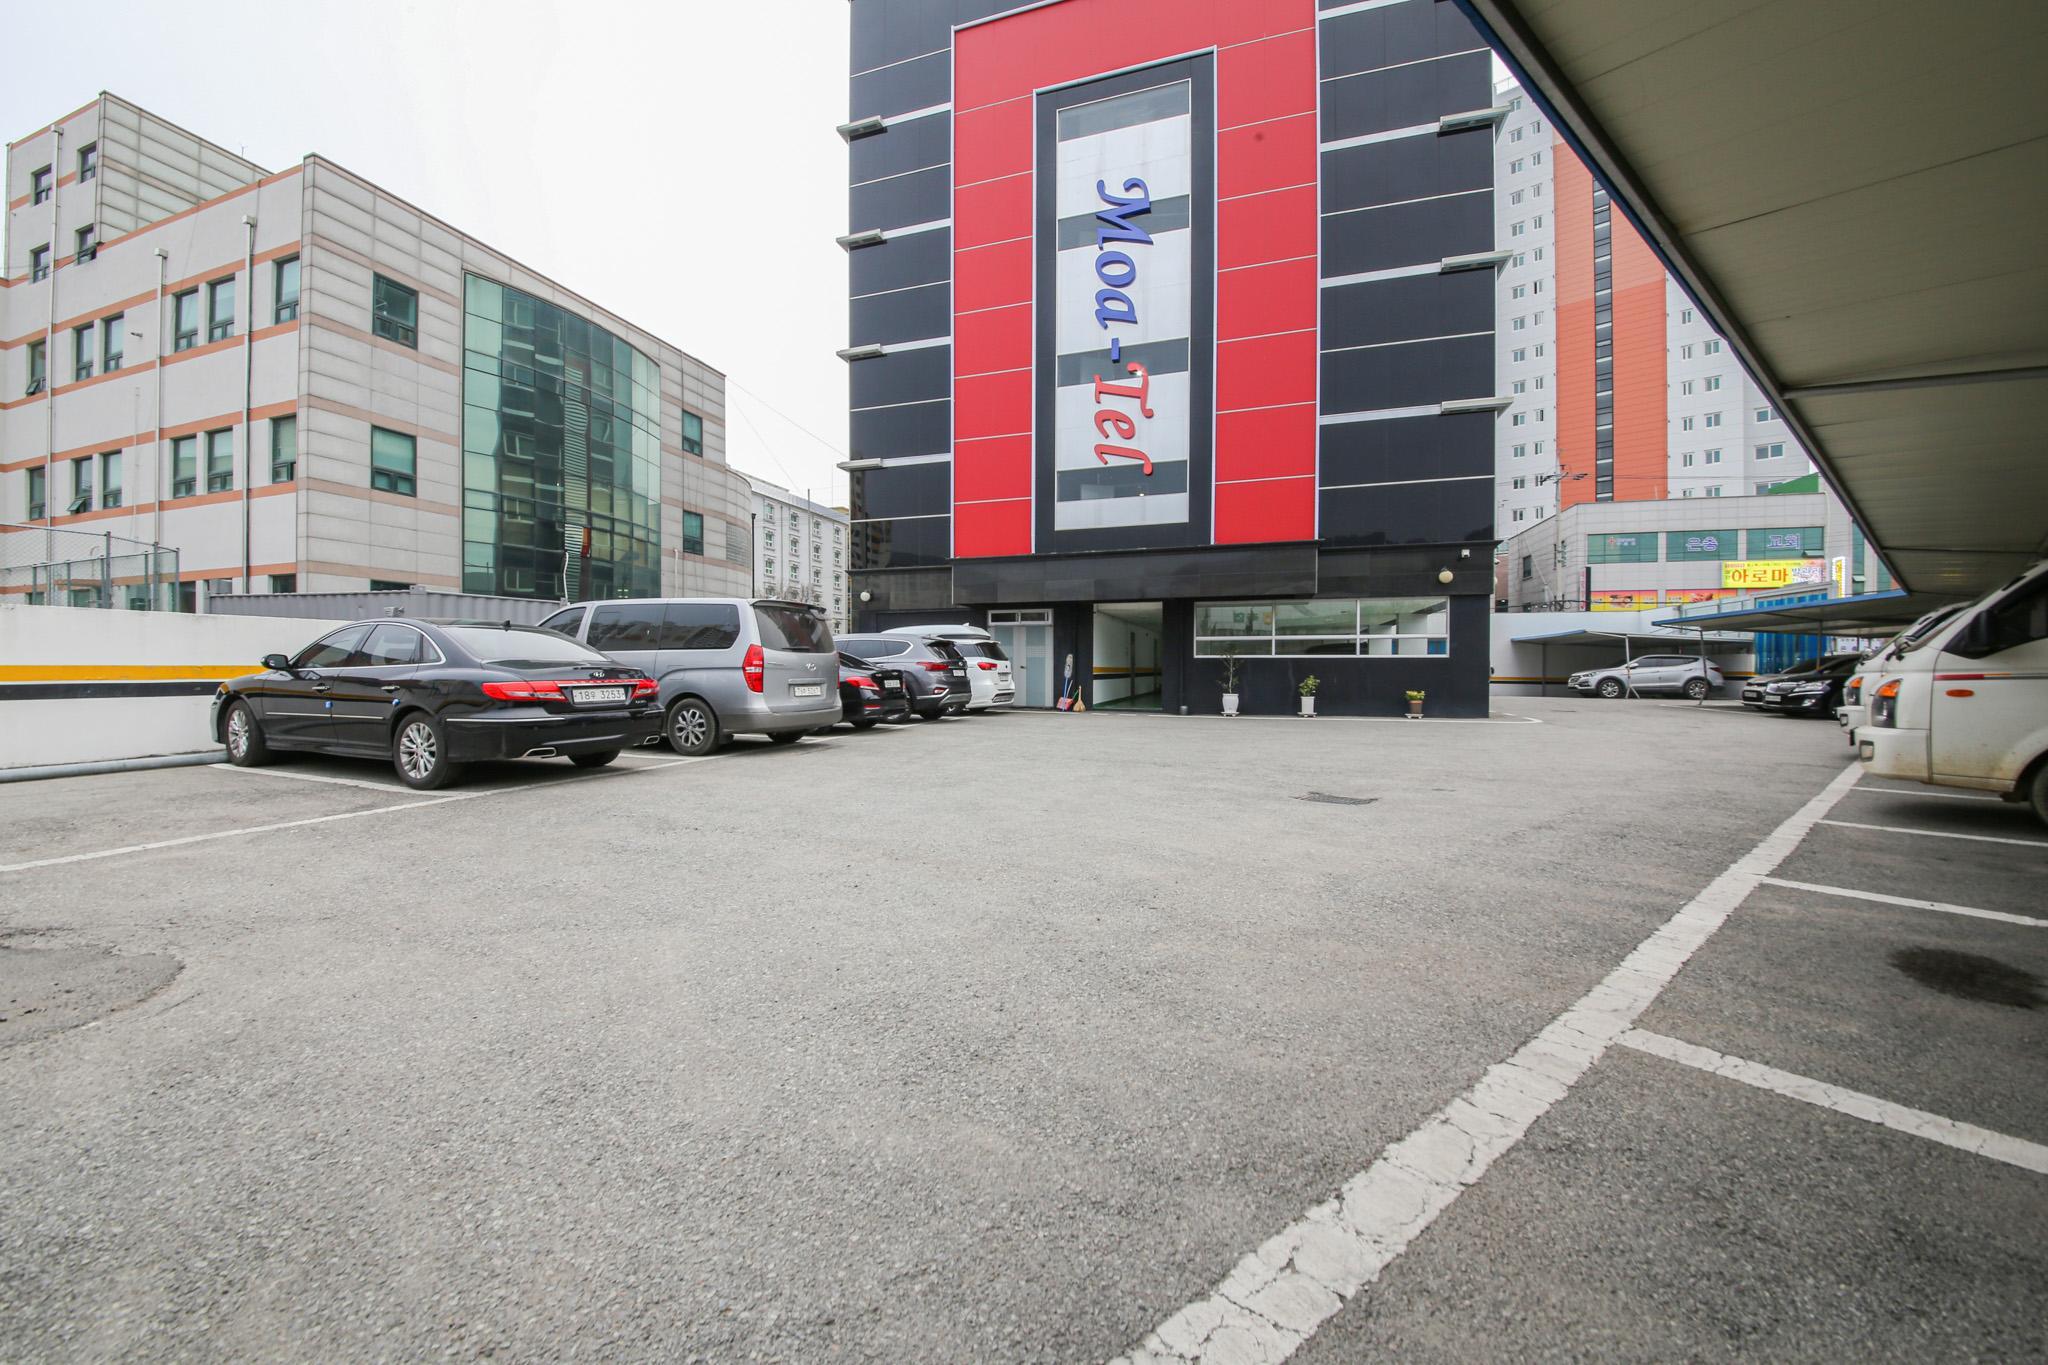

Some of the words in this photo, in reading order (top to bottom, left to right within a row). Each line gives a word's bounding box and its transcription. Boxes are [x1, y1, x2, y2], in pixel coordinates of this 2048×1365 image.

[1094, 177, 1154, 475] Moa-Tel
[1767, 533, 1801, 550] 교회
[1731, 568, 1789, 583] 아로마
[600, 690, 621, 699] 3253
